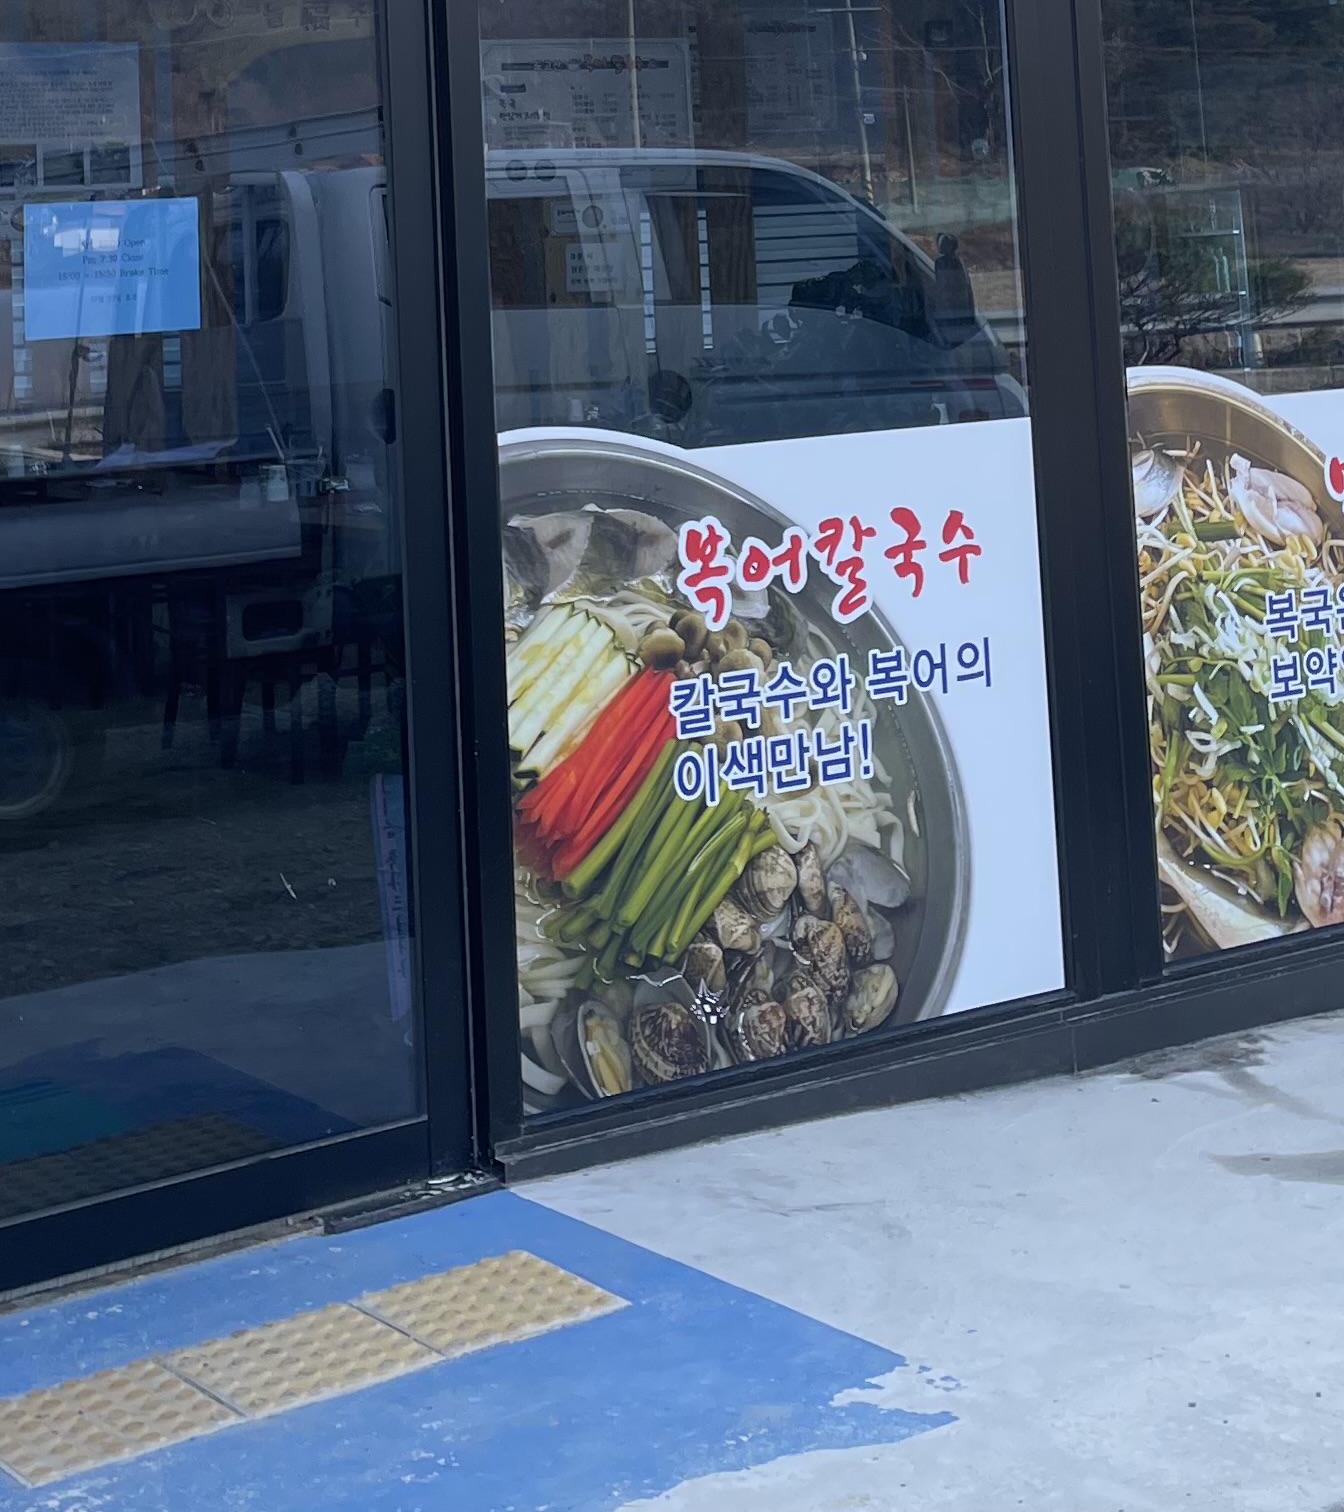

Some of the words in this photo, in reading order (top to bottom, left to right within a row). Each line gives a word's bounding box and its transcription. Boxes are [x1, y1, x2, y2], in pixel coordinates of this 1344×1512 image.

[683, 506, 982, 624] 복어칼국수
[670, 654, 856, 738] 칼국수와
[867, 636, 992, 704] 복어의
[675, 721, 874, 804] 이색만남!
